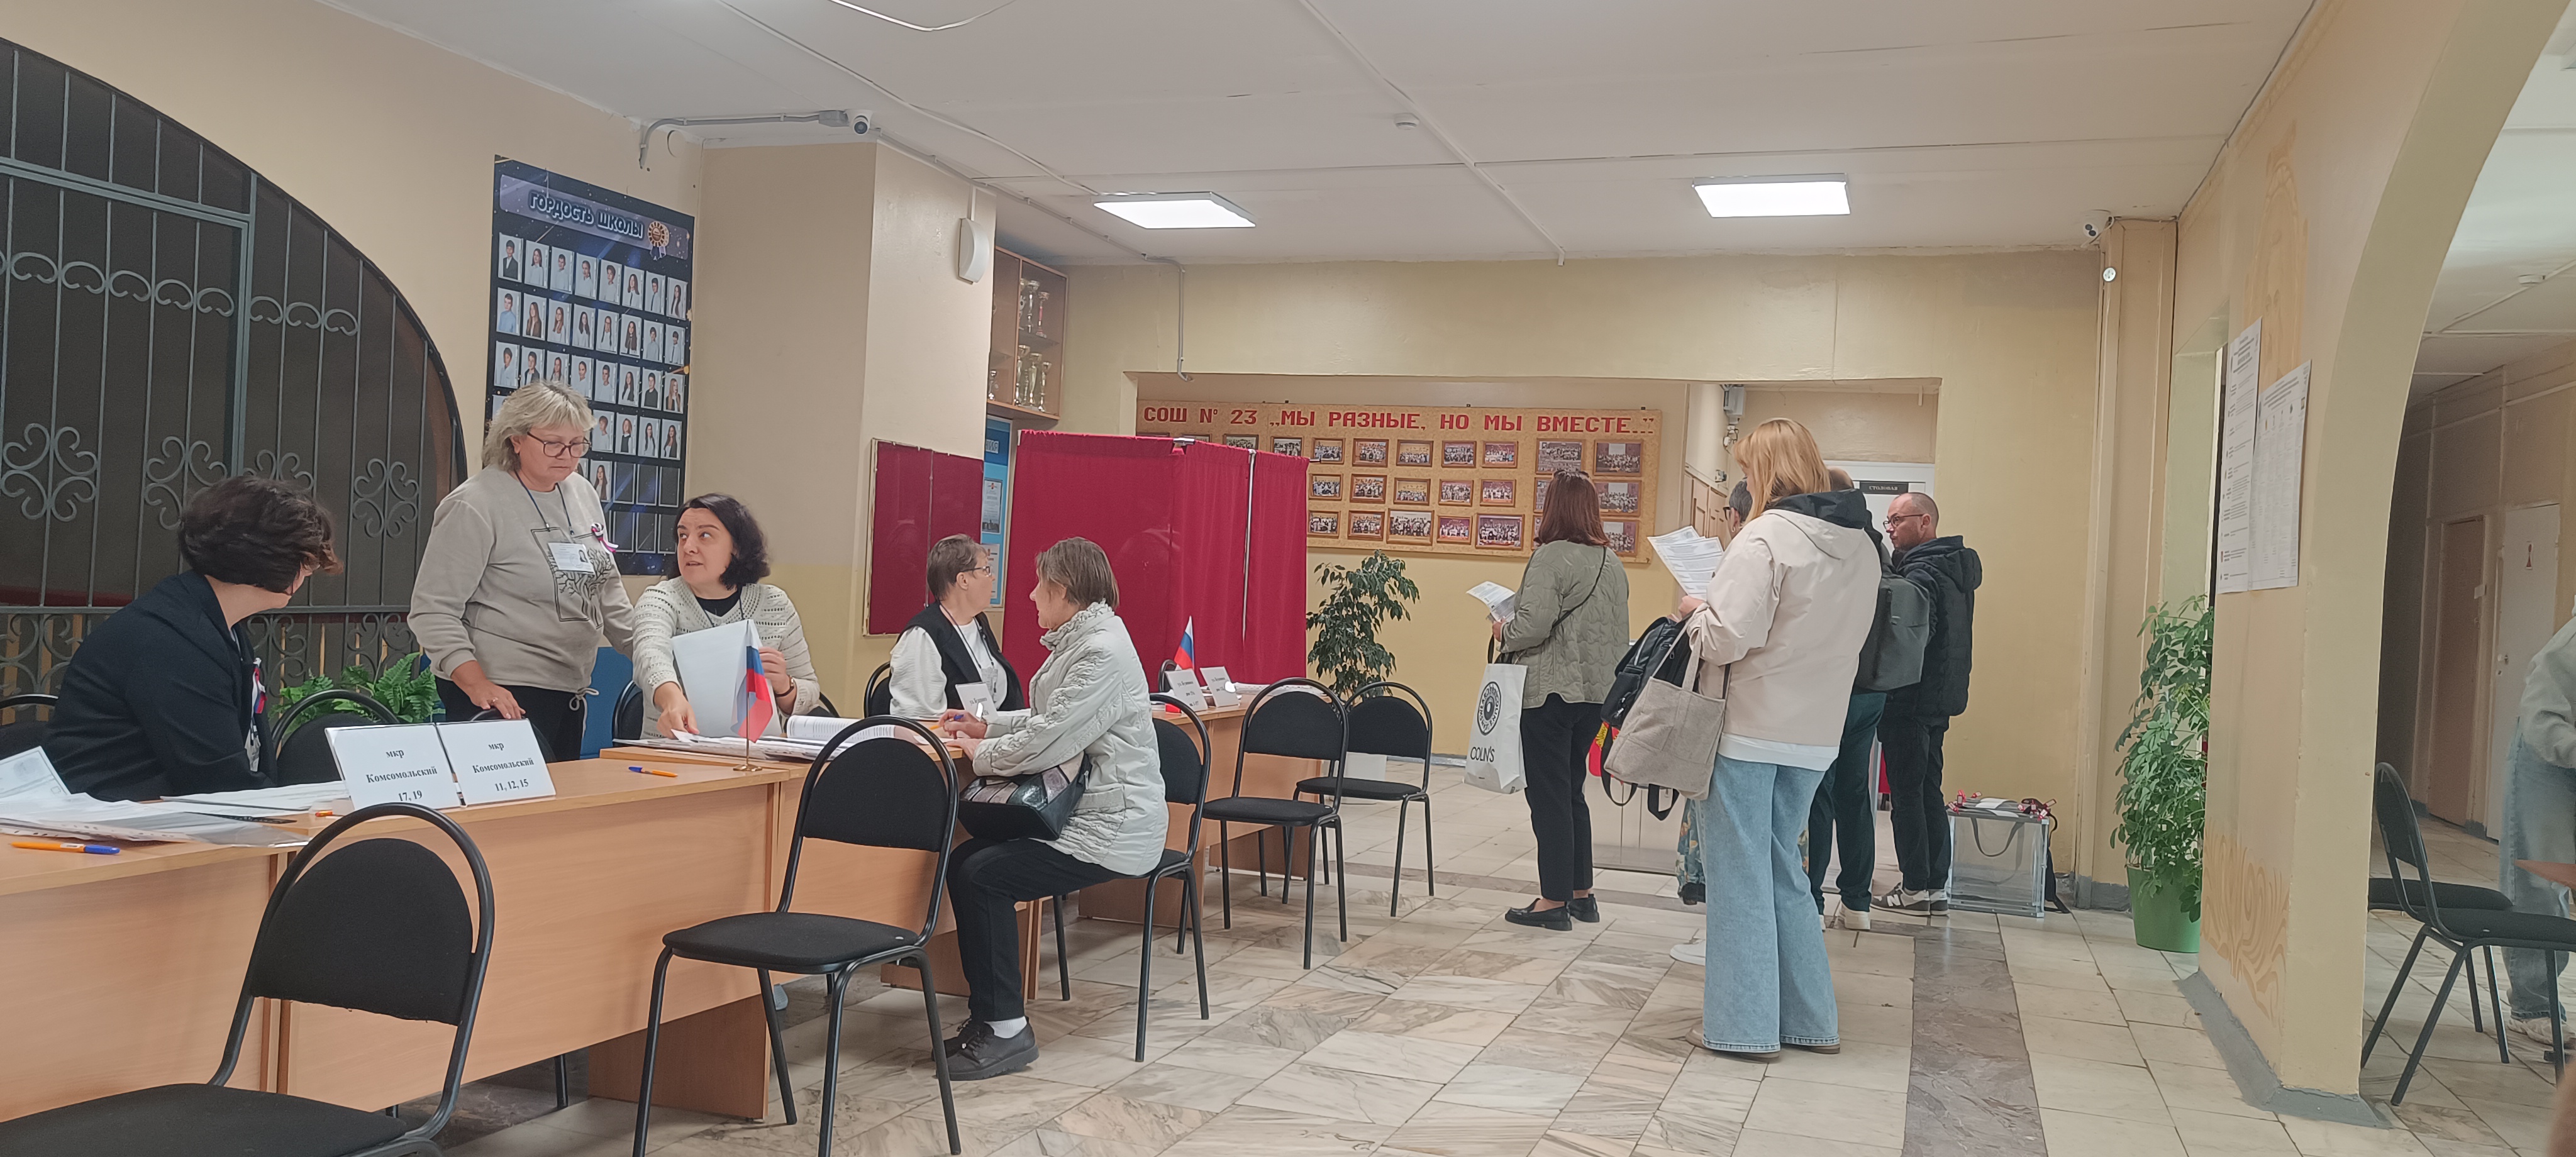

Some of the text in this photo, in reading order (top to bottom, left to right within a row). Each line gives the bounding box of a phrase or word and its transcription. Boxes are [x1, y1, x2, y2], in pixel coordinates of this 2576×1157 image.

[530, 191, 644, 239] ГОРДОСТЬ ШКОЛЫ
[1143, 407, 1187, 423] СОШ
[1230, 409, 1258, 424] 23
[1328, 411, 1426, 431] РАЗНЫЕ,
[1440, 414, 1470, 430] НО
[1484, 415, 1522, 431] МЫ
[386, 748, 404, 758] мкр
[487, 741, 504, 752] мкр
[1470, 745, 1495, 763] COLIN'S
[472, 757, 535, 774] Комсомольский
[365, 766, 438, 783] Комсомольский
[494, 778, 529, 792] 11, 12, 15
[398, 790, 423, 802] 17, 19
[1887, 894, 1901, 907] N
